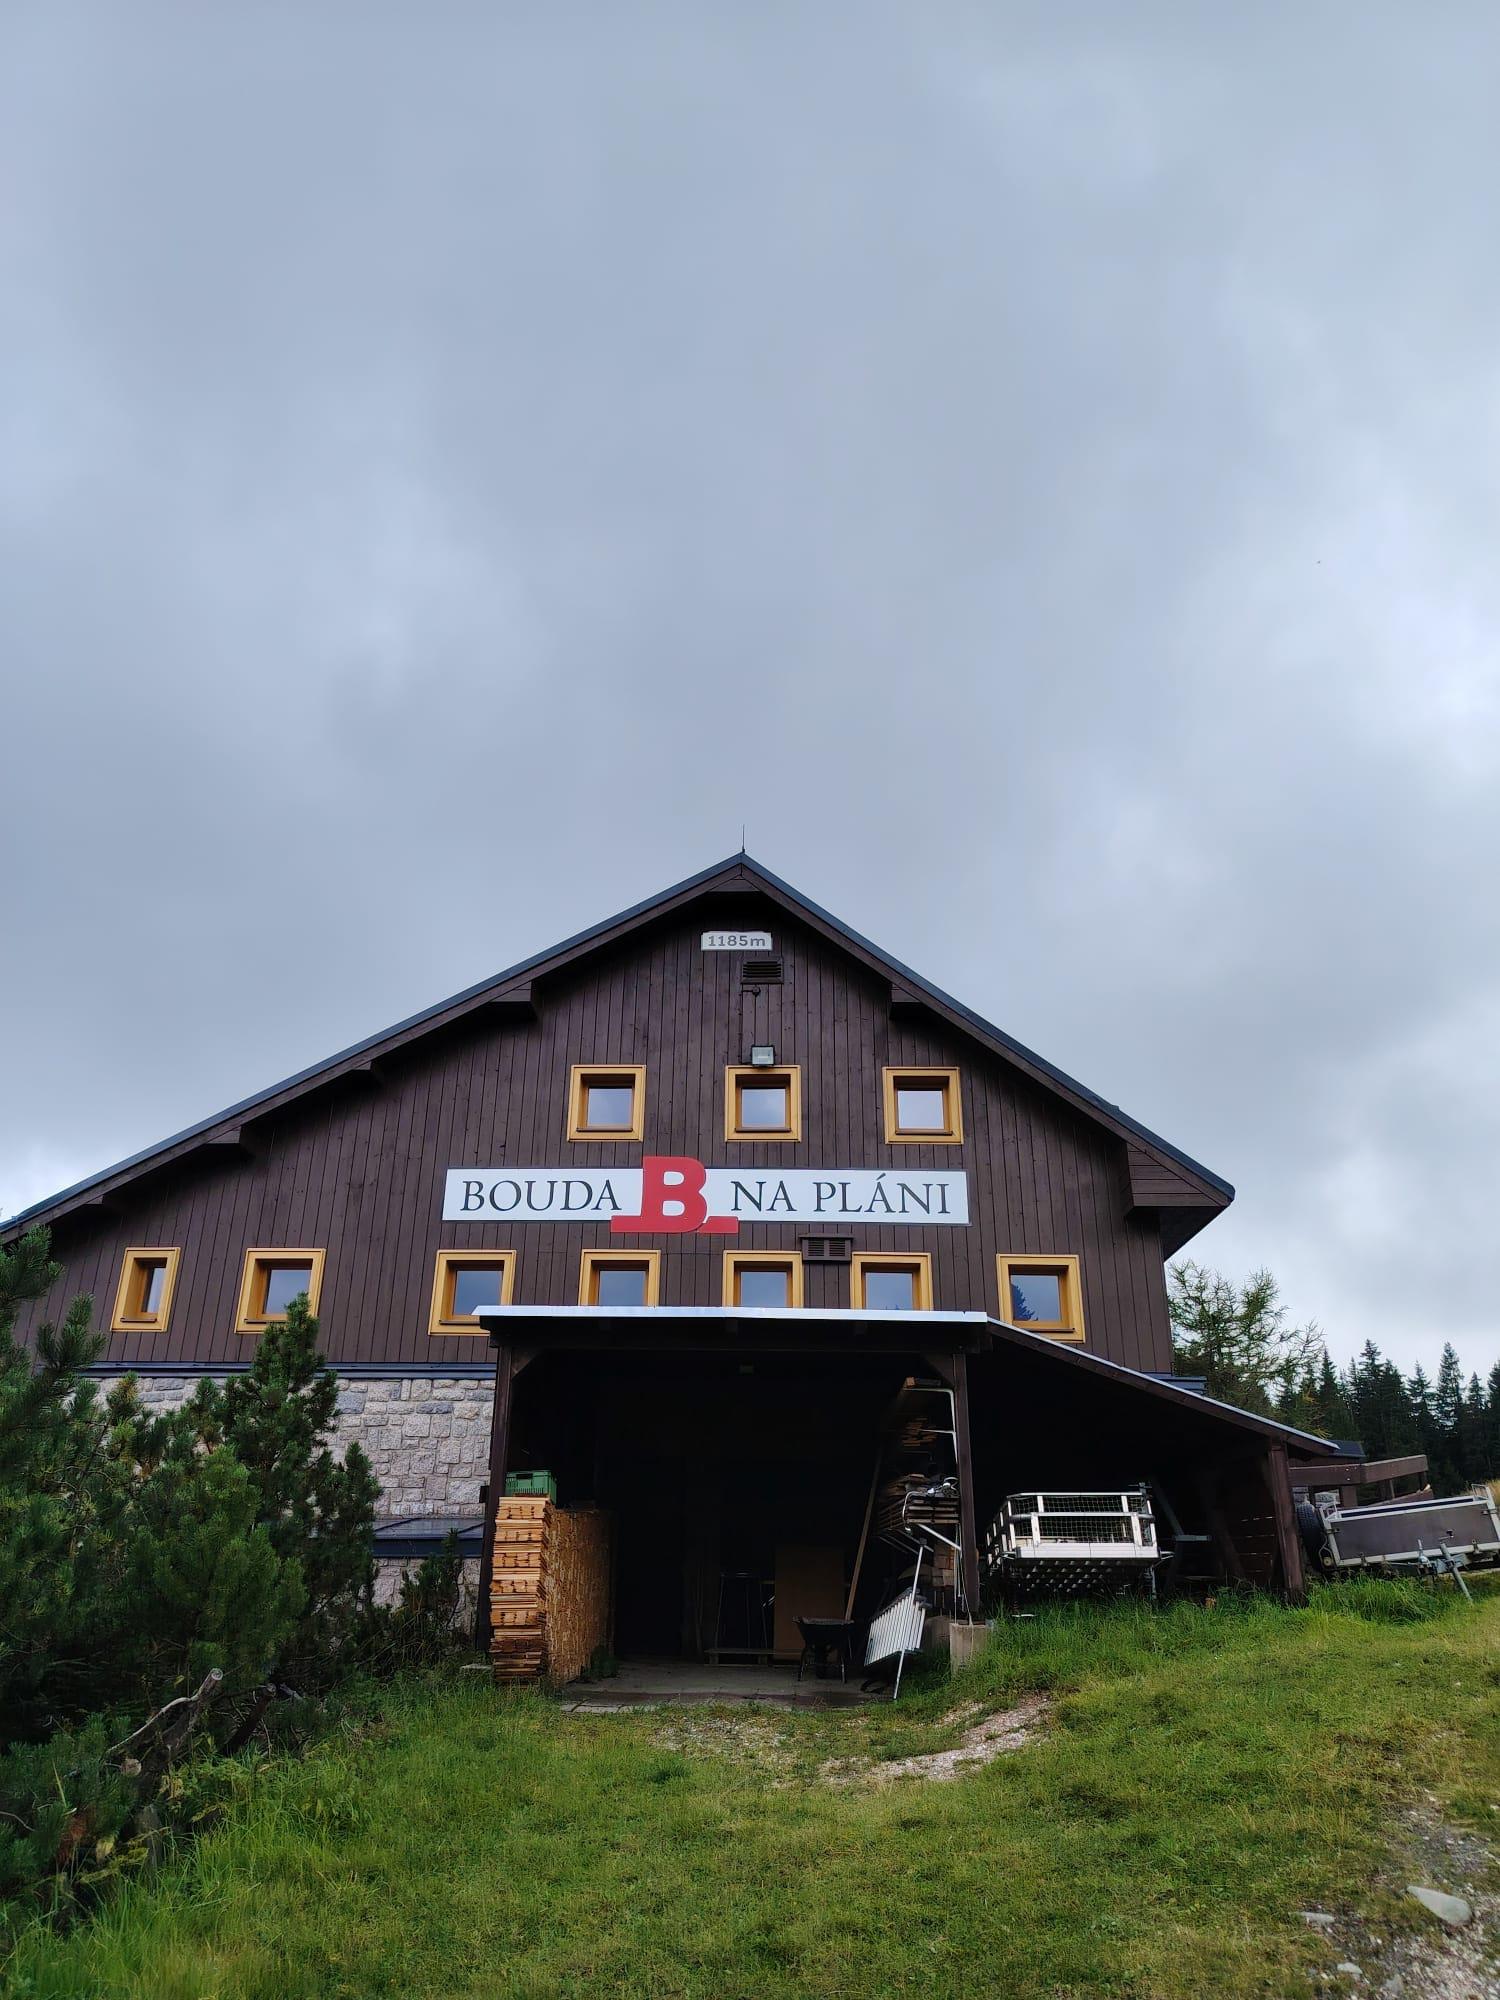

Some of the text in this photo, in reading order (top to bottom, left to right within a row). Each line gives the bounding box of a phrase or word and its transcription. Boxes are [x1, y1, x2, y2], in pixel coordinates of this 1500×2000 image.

[708, 935, 766, 947] 1185m
[460, 1156, 951, 1233] BOUDA B NA PLÁNI
